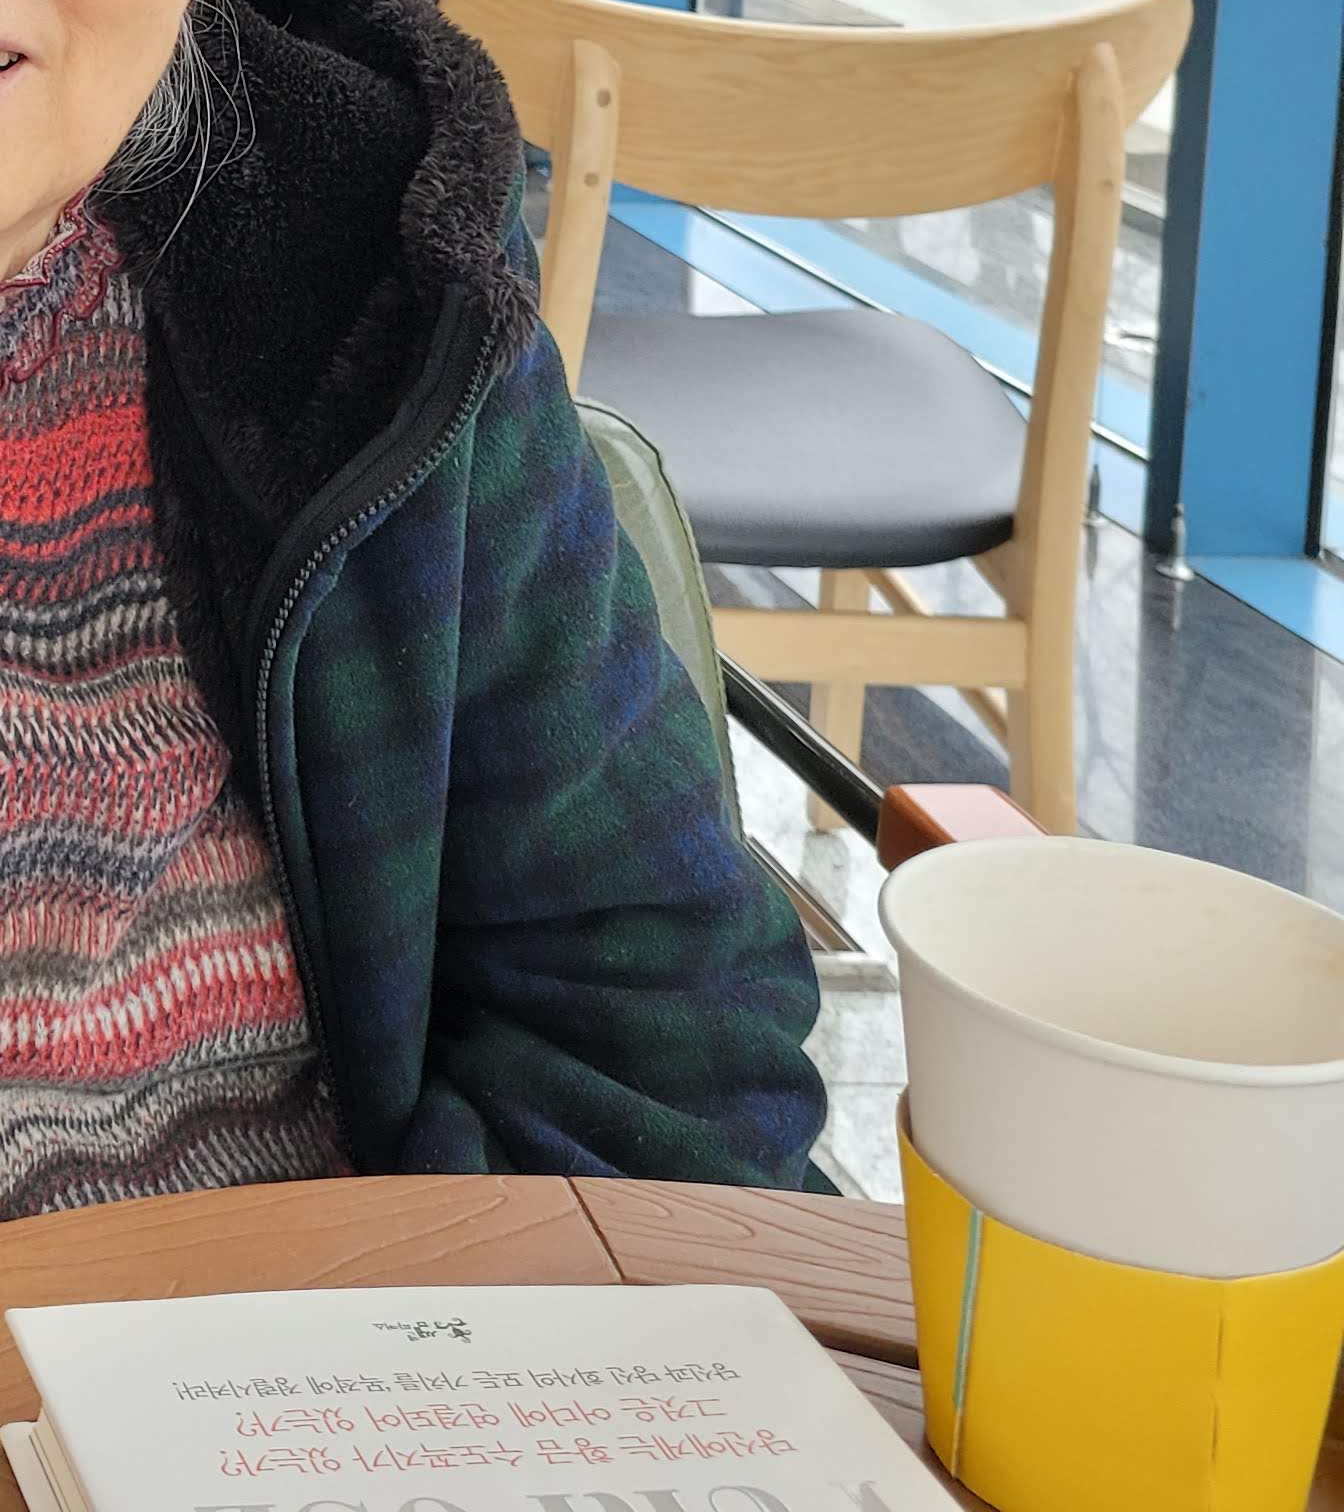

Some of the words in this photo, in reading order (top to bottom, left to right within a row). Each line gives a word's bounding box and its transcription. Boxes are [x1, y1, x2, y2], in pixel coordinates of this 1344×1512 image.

[393, 1370, 468, 1392] 가치를
[471, 1370, 524, 1390] 모든
[528, 1368, 604, 1388] 회사의
[606, 1365, 659, 1386] 당신
[663, 1362, 743, 1384] 당신과
[172, 1375, 304, 1401] 정렬시켜라!
[235, 1405, 355, 1437] 있는가?
[364, 1402, 501, 1432] 연결되어
[507, 1399, 613, 1428] 어디에
[618, 1395, 728, 1424] 그것은
[352, 1439, 525, 1473] 수도꼭지가
[536, 1437, 615, 1466] 황금
[616, 1428, 800, 1462] 당신에게는
[219, 1445, 342, 1477] 있는가?
